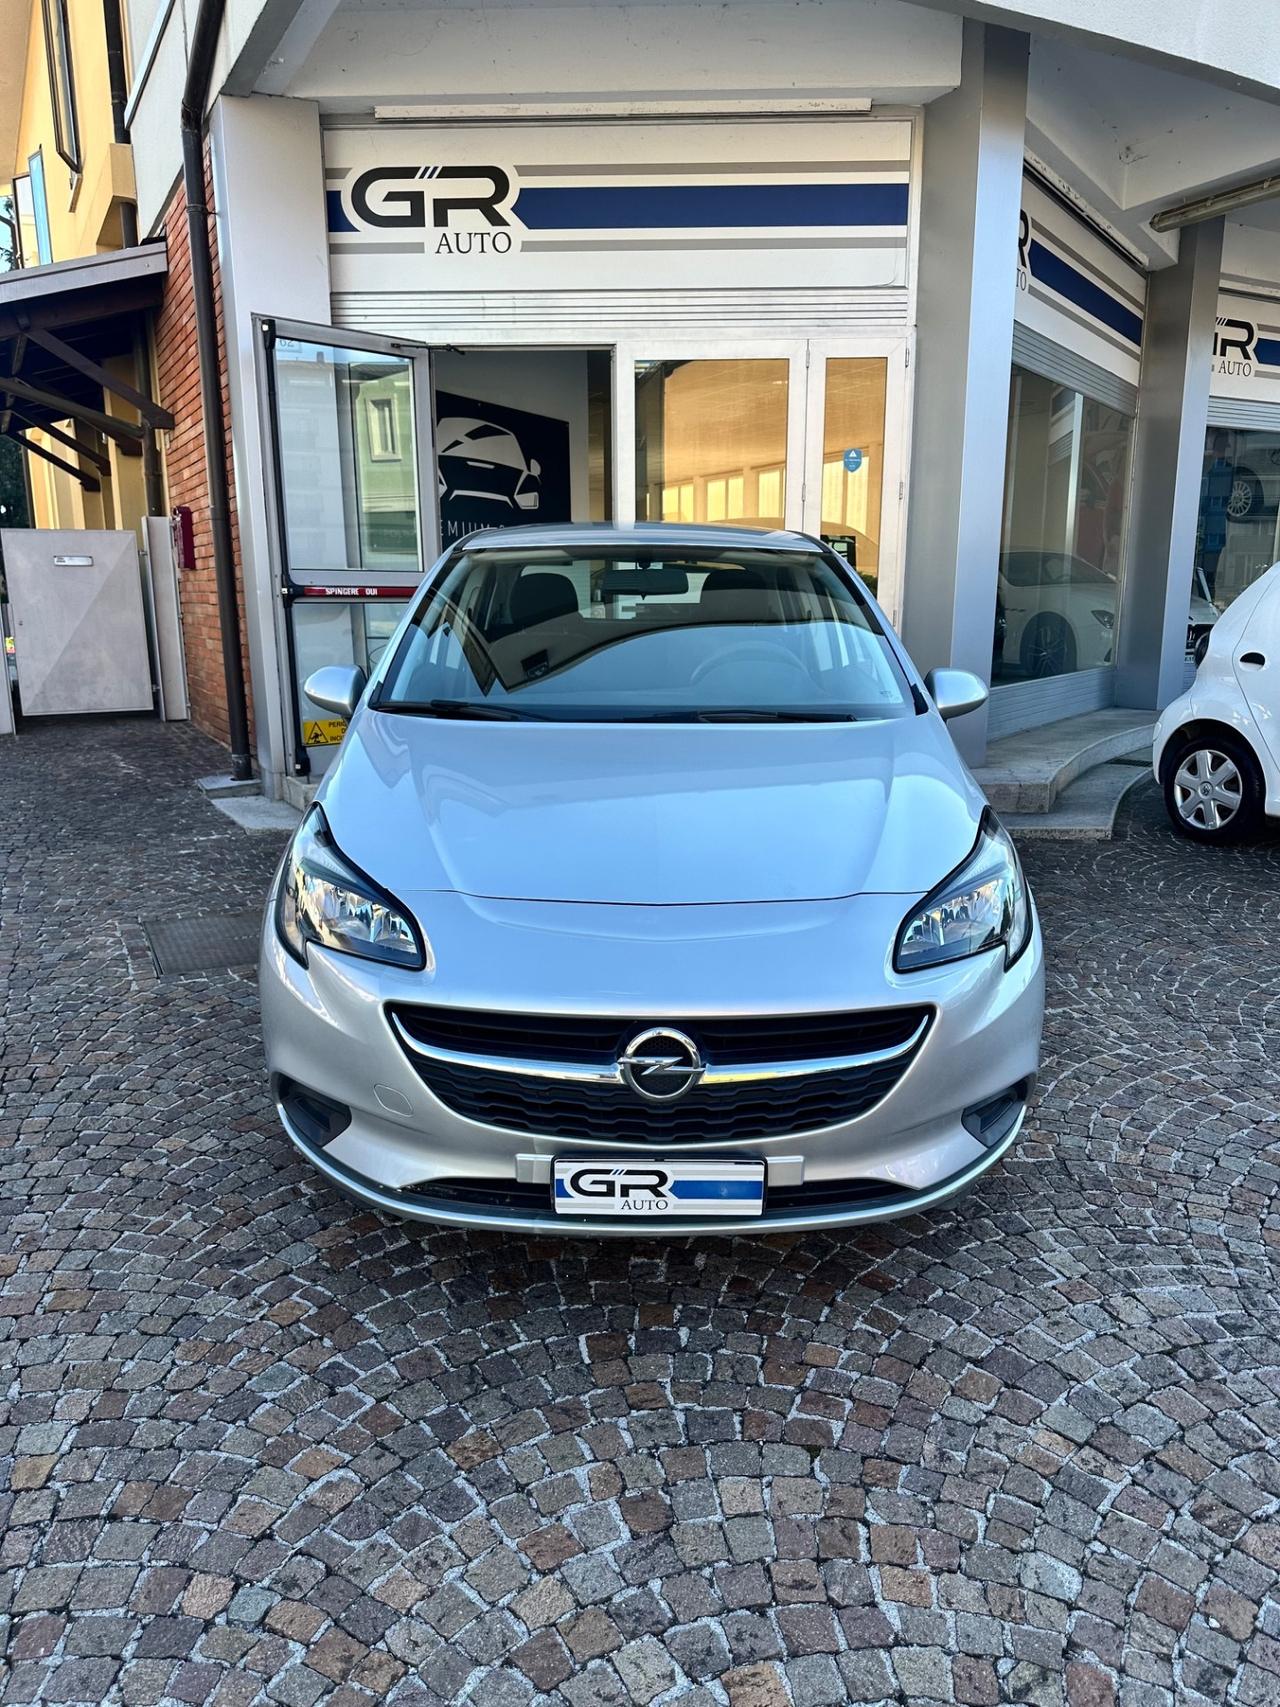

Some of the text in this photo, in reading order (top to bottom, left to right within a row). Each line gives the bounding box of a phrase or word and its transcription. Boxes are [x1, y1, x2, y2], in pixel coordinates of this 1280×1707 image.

[351, 166, 511, 228] GR
[435, 232, 512, 254] AUTO
[1218, 360, 1252, 377] AUTO
[570, 1168, 668, 1198] GR
[621, 1199, 668, 1211] AUTO
